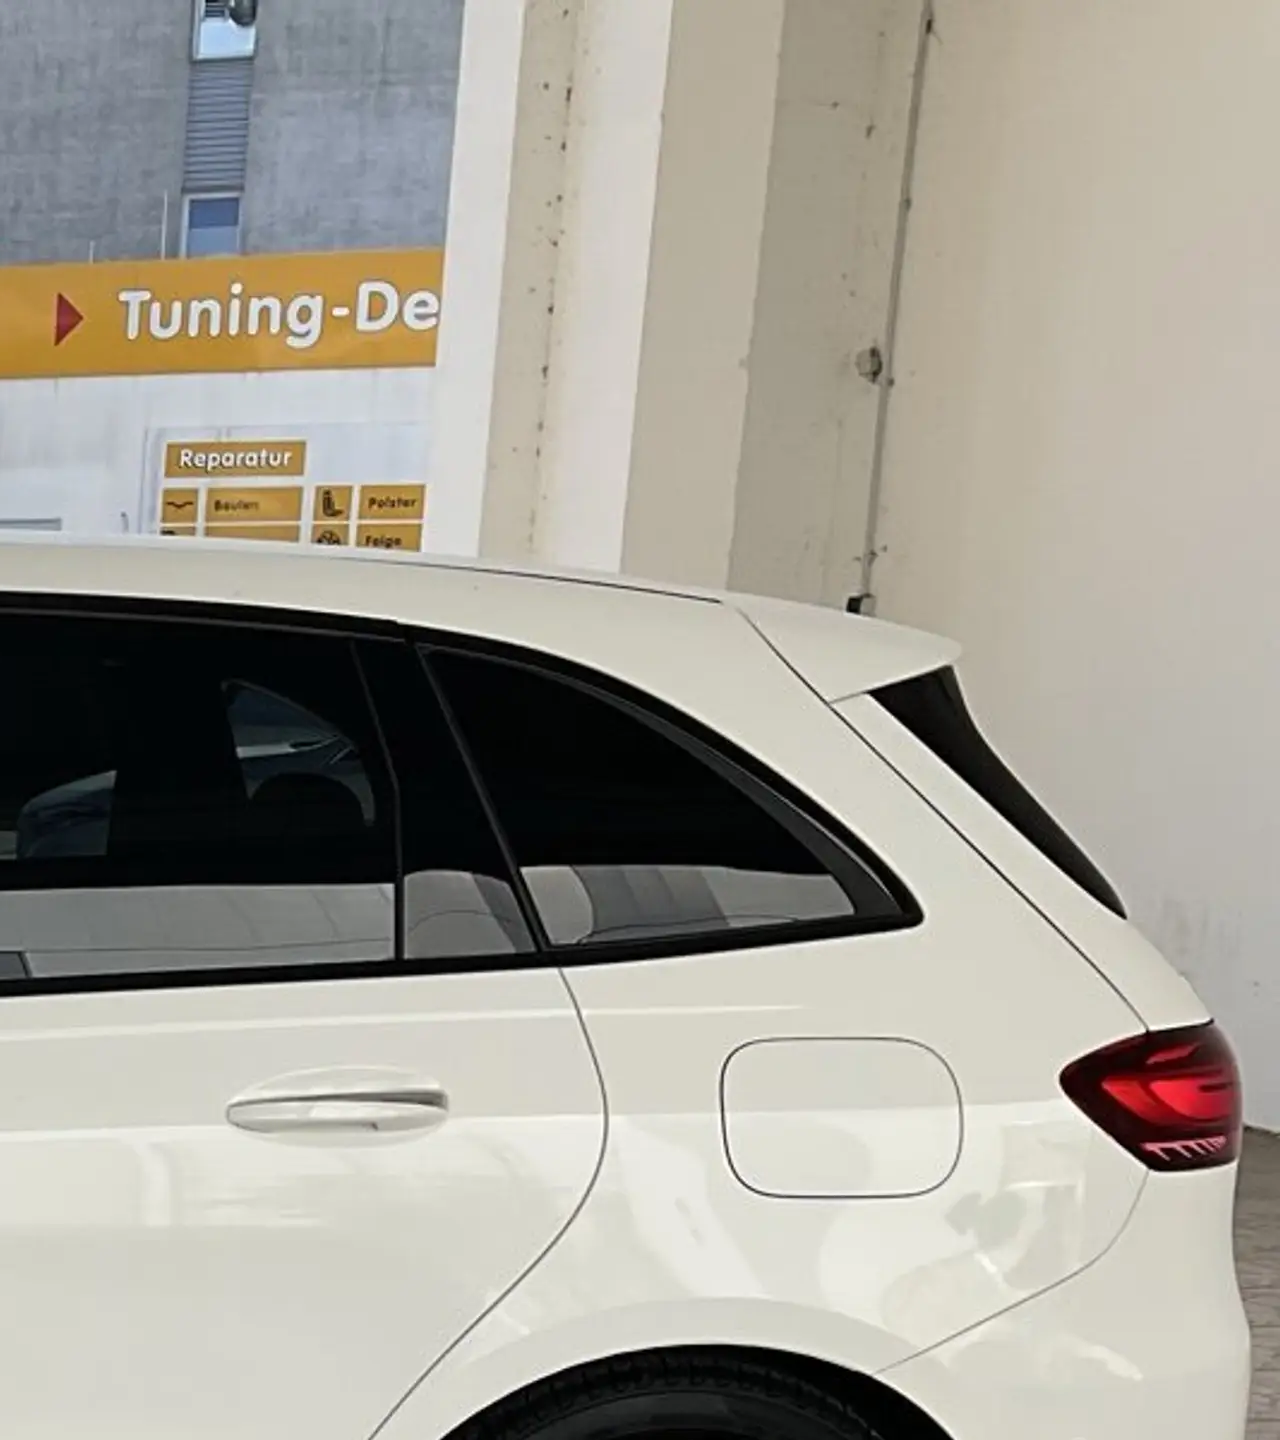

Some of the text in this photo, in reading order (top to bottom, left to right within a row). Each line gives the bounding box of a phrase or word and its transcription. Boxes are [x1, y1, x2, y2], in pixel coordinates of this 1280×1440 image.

[117, 280, 439, 349] Tuning-De
[179, 447, 293, 473] Reparatur
[367, 496, 417, 509] Polster
